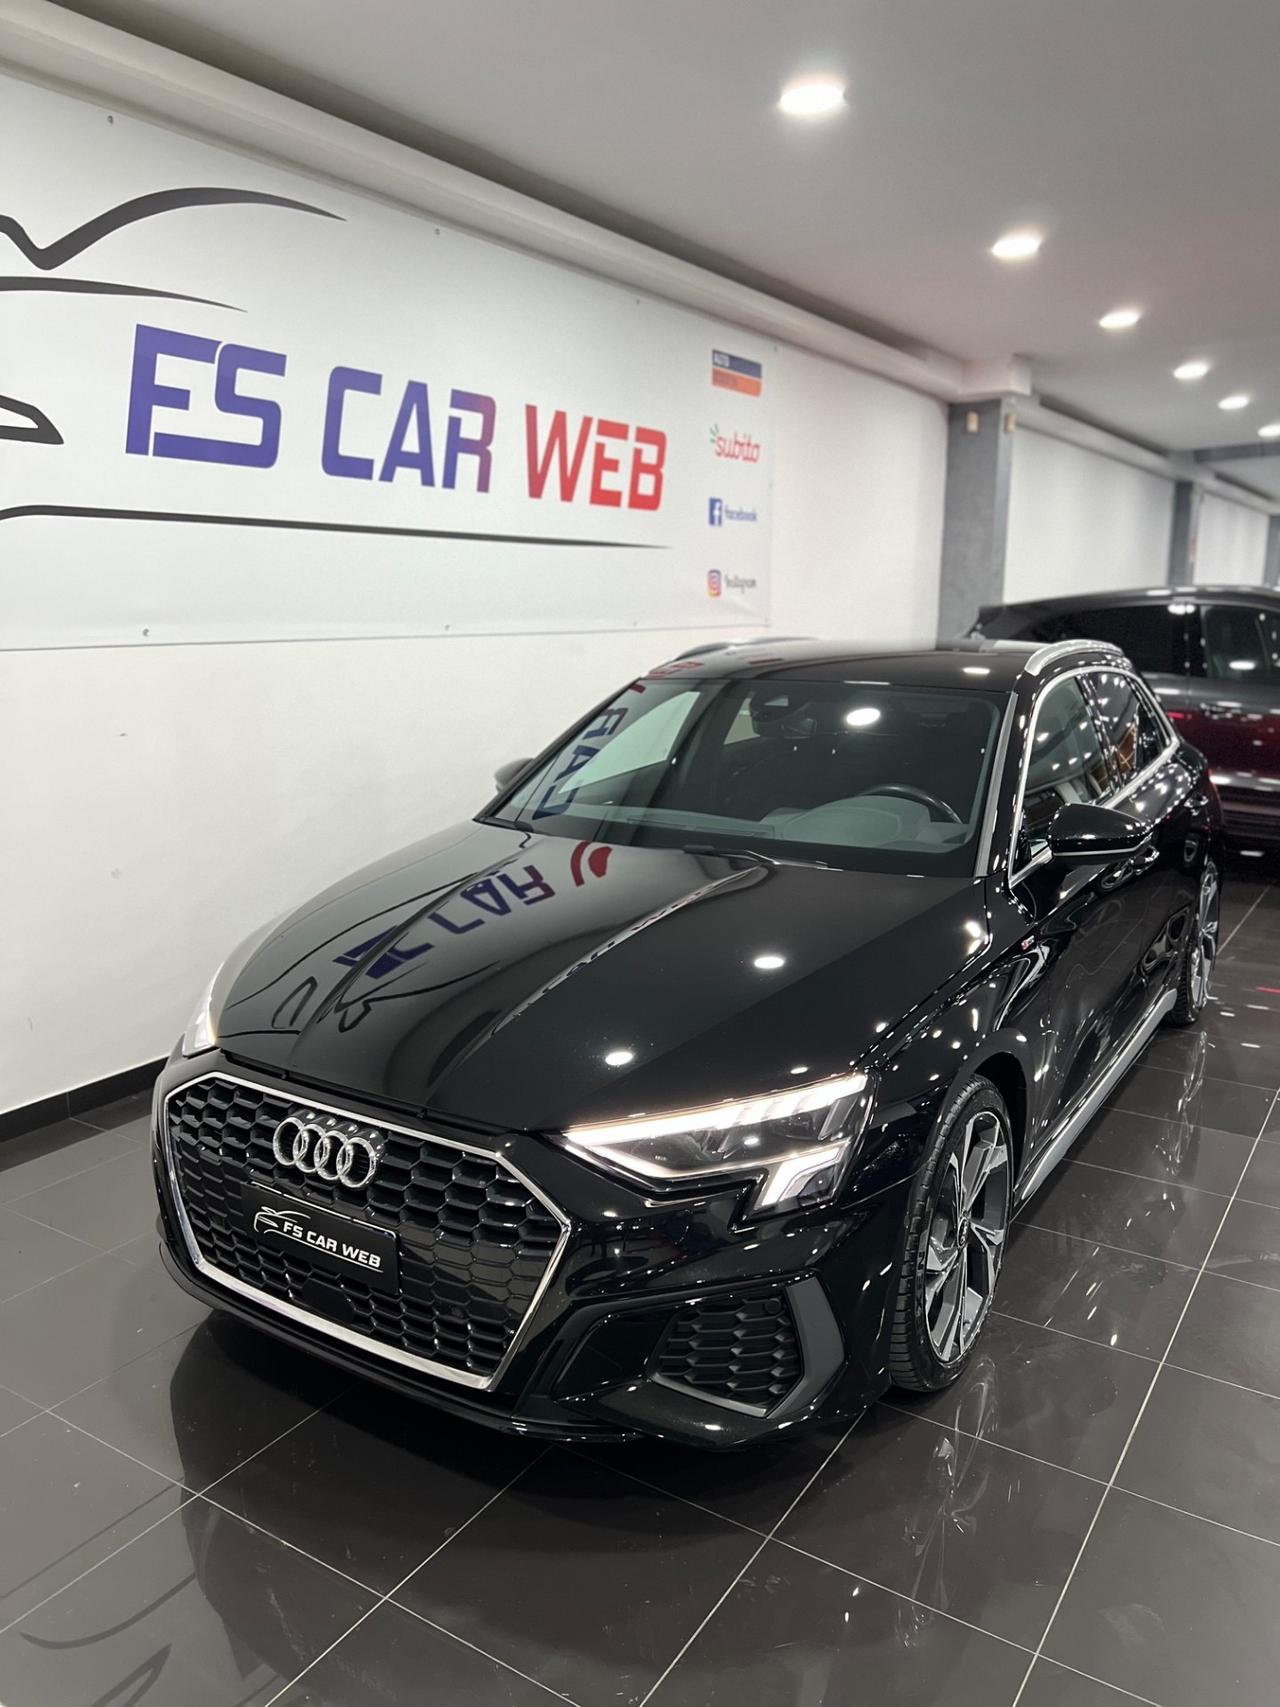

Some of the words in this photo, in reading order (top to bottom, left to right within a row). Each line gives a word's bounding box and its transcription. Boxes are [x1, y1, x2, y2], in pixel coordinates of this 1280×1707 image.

[321, 366, 496, 493] CAR
[525, 405, 667, 511] WEB
[715, 431, 760, 463] subito
[283, 1221, 303, 1238] FS
[306, 1231, 338, 1252] CAR
[342, 1243, 381, 1268] WEB
